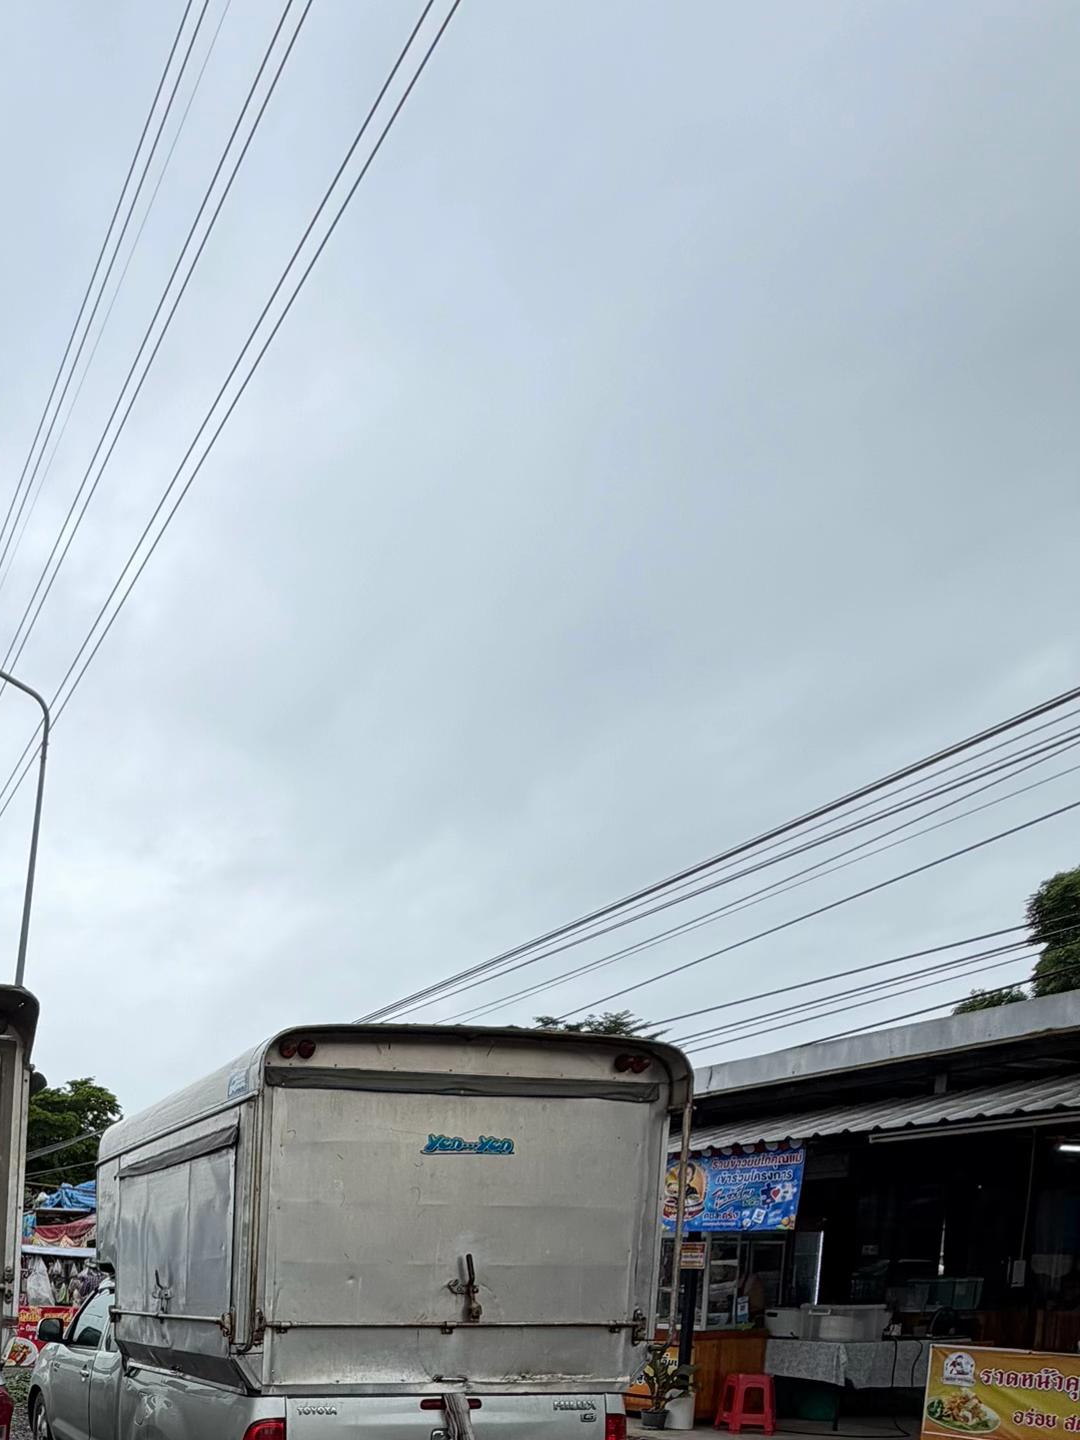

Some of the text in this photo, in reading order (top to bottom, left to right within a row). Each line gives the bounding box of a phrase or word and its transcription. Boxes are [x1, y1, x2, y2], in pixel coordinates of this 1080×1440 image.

[715, 1167, 794, 1185] เข้าร่วมโครงการ
[296, 1405, 338, 1416] TOYOTA
[553, 1400, 596, 1411] HILUX
[1013, 1407, 1057, 1428] อร่อย
